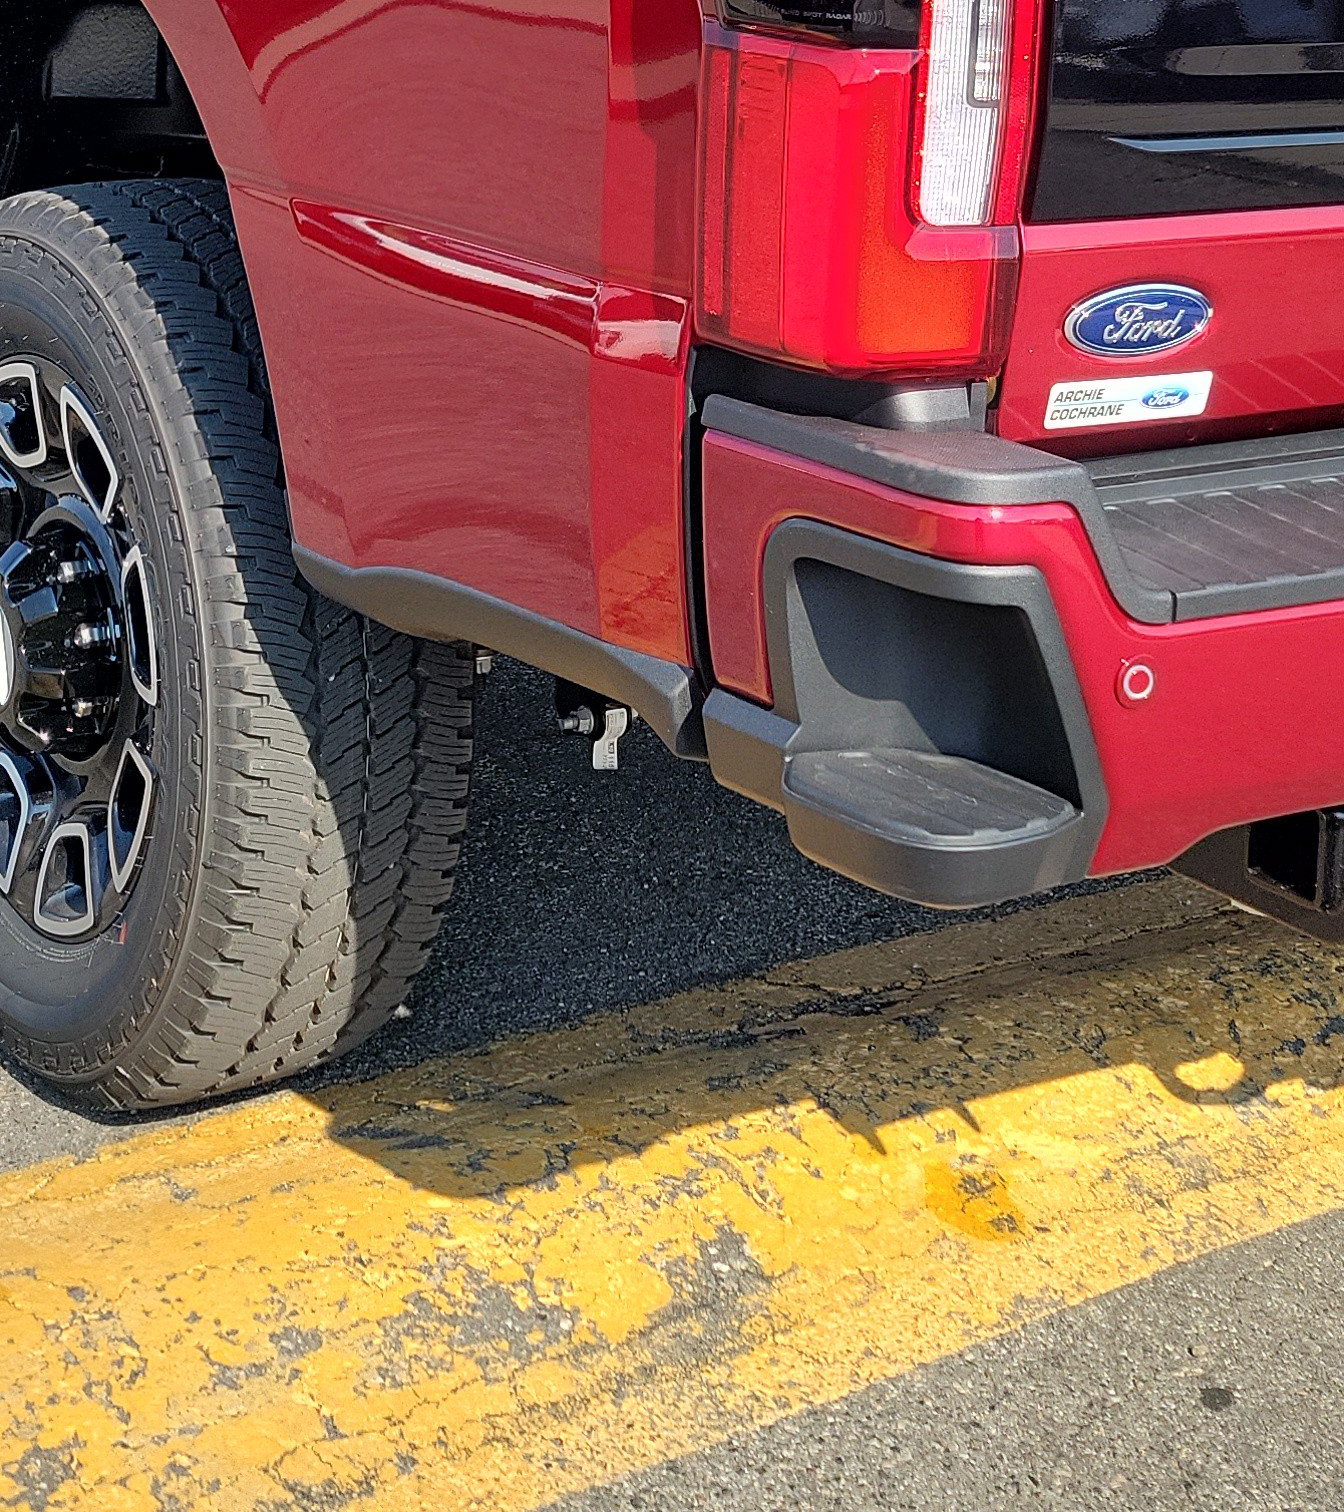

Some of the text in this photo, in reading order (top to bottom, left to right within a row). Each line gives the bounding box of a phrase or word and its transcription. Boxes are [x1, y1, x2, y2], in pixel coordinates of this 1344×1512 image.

[825, 12, 852, 20] RADAR
[1103, 302, 1185, 344] Ford
[1054, 389, 1184, 407] ARCHIE Ford
[1050, 404, 1125, 421] COCHRANE
